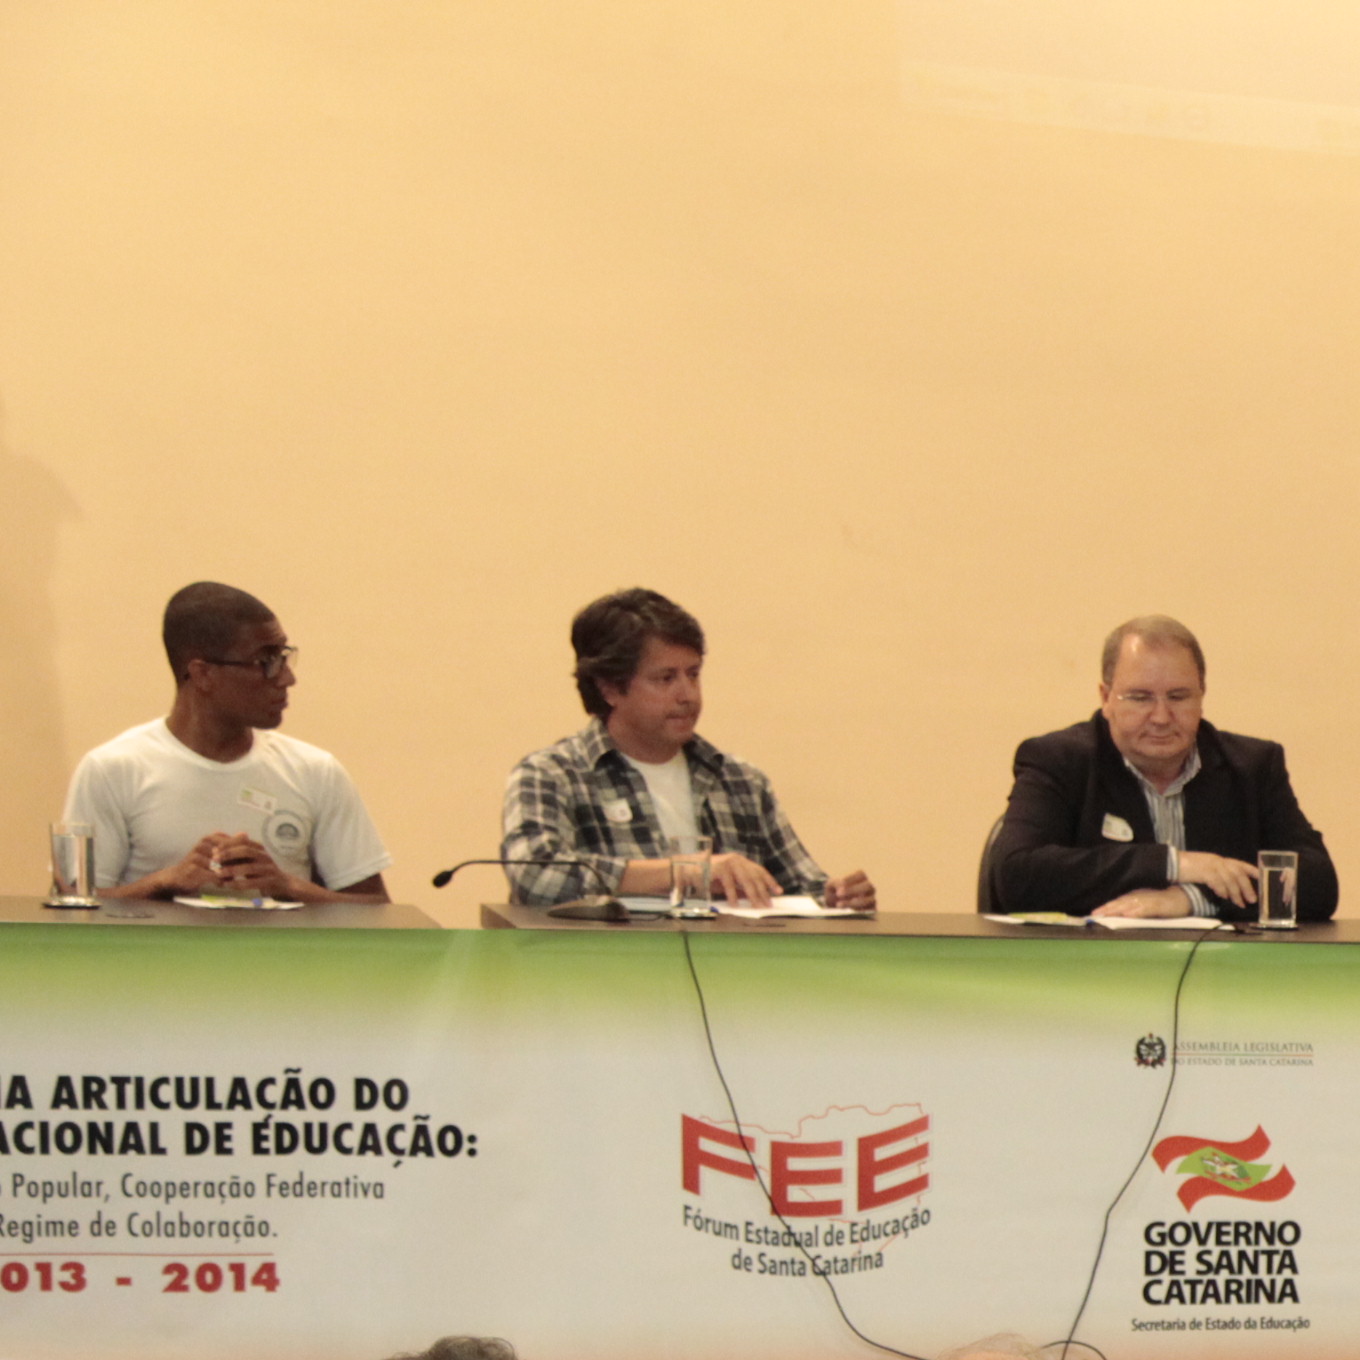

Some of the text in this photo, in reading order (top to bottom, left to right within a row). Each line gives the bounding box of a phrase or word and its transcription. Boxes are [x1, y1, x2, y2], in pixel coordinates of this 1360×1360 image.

[1245, 1042, 1313, 1052] LEGISLATIVA
[0, 1075, 33, 1110] A
[354, 1077, 410, 1112] DO
[184, 1121, 234, 1156] DE
[681, 1113, 930, 1217] FEE
[12, 1171, 386, 1205] Popular, Cooperação Federativa
[90, 1210, 117, 1238] de
[127, 1210, 278, 1244] Colaboração.
[683, 1204, 931, 1249] Fórum Estadual de Educação
[1144, 1221, 1302, 1247] GOVERNO
[0, 1262, 87, 1293] 013
[162, 1262, 280, 1293] 2014
[731, 1248, 884, 1277] de Santa Catarina
[1144, 1249, 1299, 1276] DE SANTA
[1142, 1278, 1300, 1305] CATARINA
[1131, 1316, 1311, 1333] Secretaria de Estado da Educação
